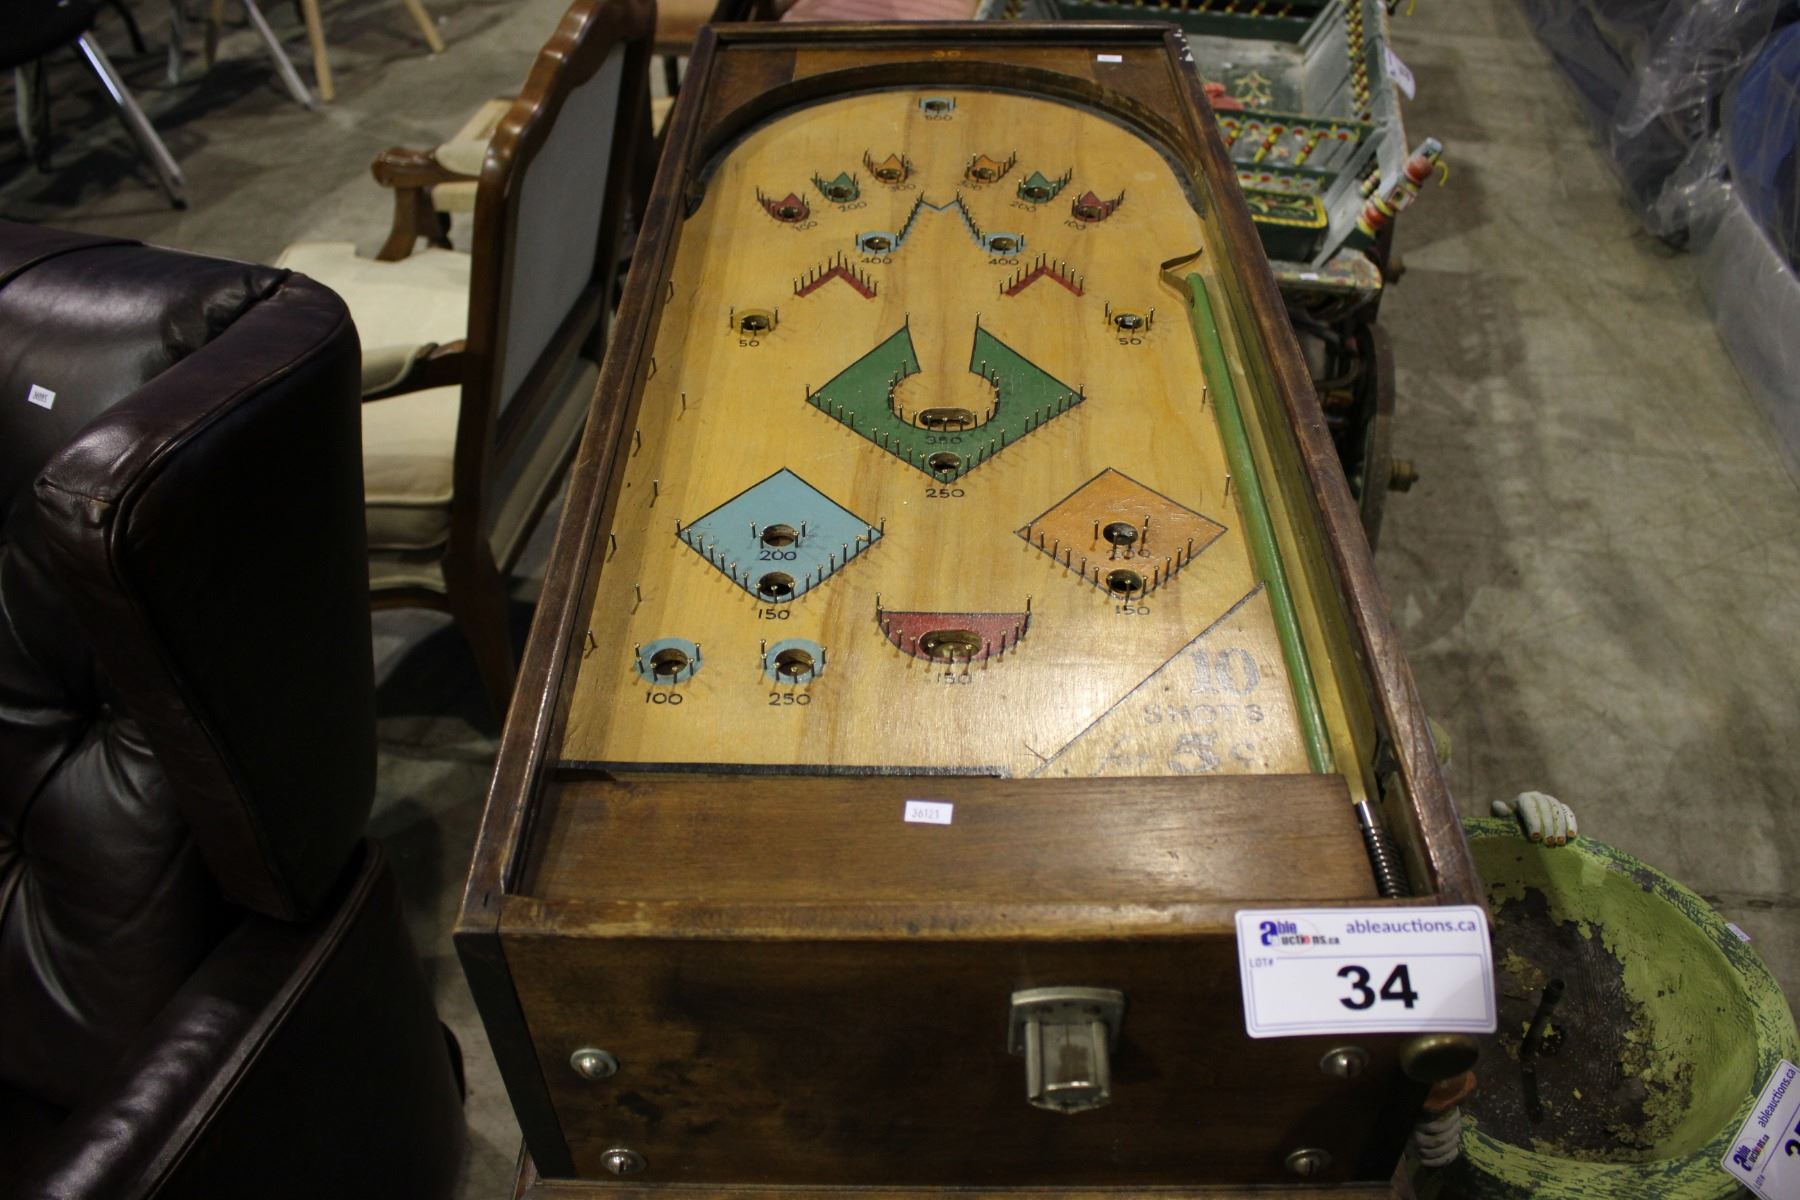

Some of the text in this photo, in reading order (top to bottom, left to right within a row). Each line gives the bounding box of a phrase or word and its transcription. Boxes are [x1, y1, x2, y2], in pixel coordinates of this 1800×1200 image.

[837, 202, 867, 212] 200
[1010, 200, 1037, 212] 200
[1064, 219, 1086, 230] 100
[861, 256, 893, 265] 400
[988, 257, 1019, 266] 400
[739, 339, 760, 348] 50
[1119, 337, 1142, 346] 50
[925, 488, 965, 498] 250
[760, 550, 797, 561] 200
[758, 608, 790, 620] 150
[1115, 605, 1150, 616] 150
[1189, 647, 1260, 695] 10
[645, 691, 683, 705] 100
[768, 691, 811, 706] 250
[1346, 917, 1477, 936] ableauctions.ca
[1249, 958, 1275, 968] LOT#
[1337, 964, 1418, 1010] 34
[1758, 1068, 1796, 1128] ableauctions.ca
